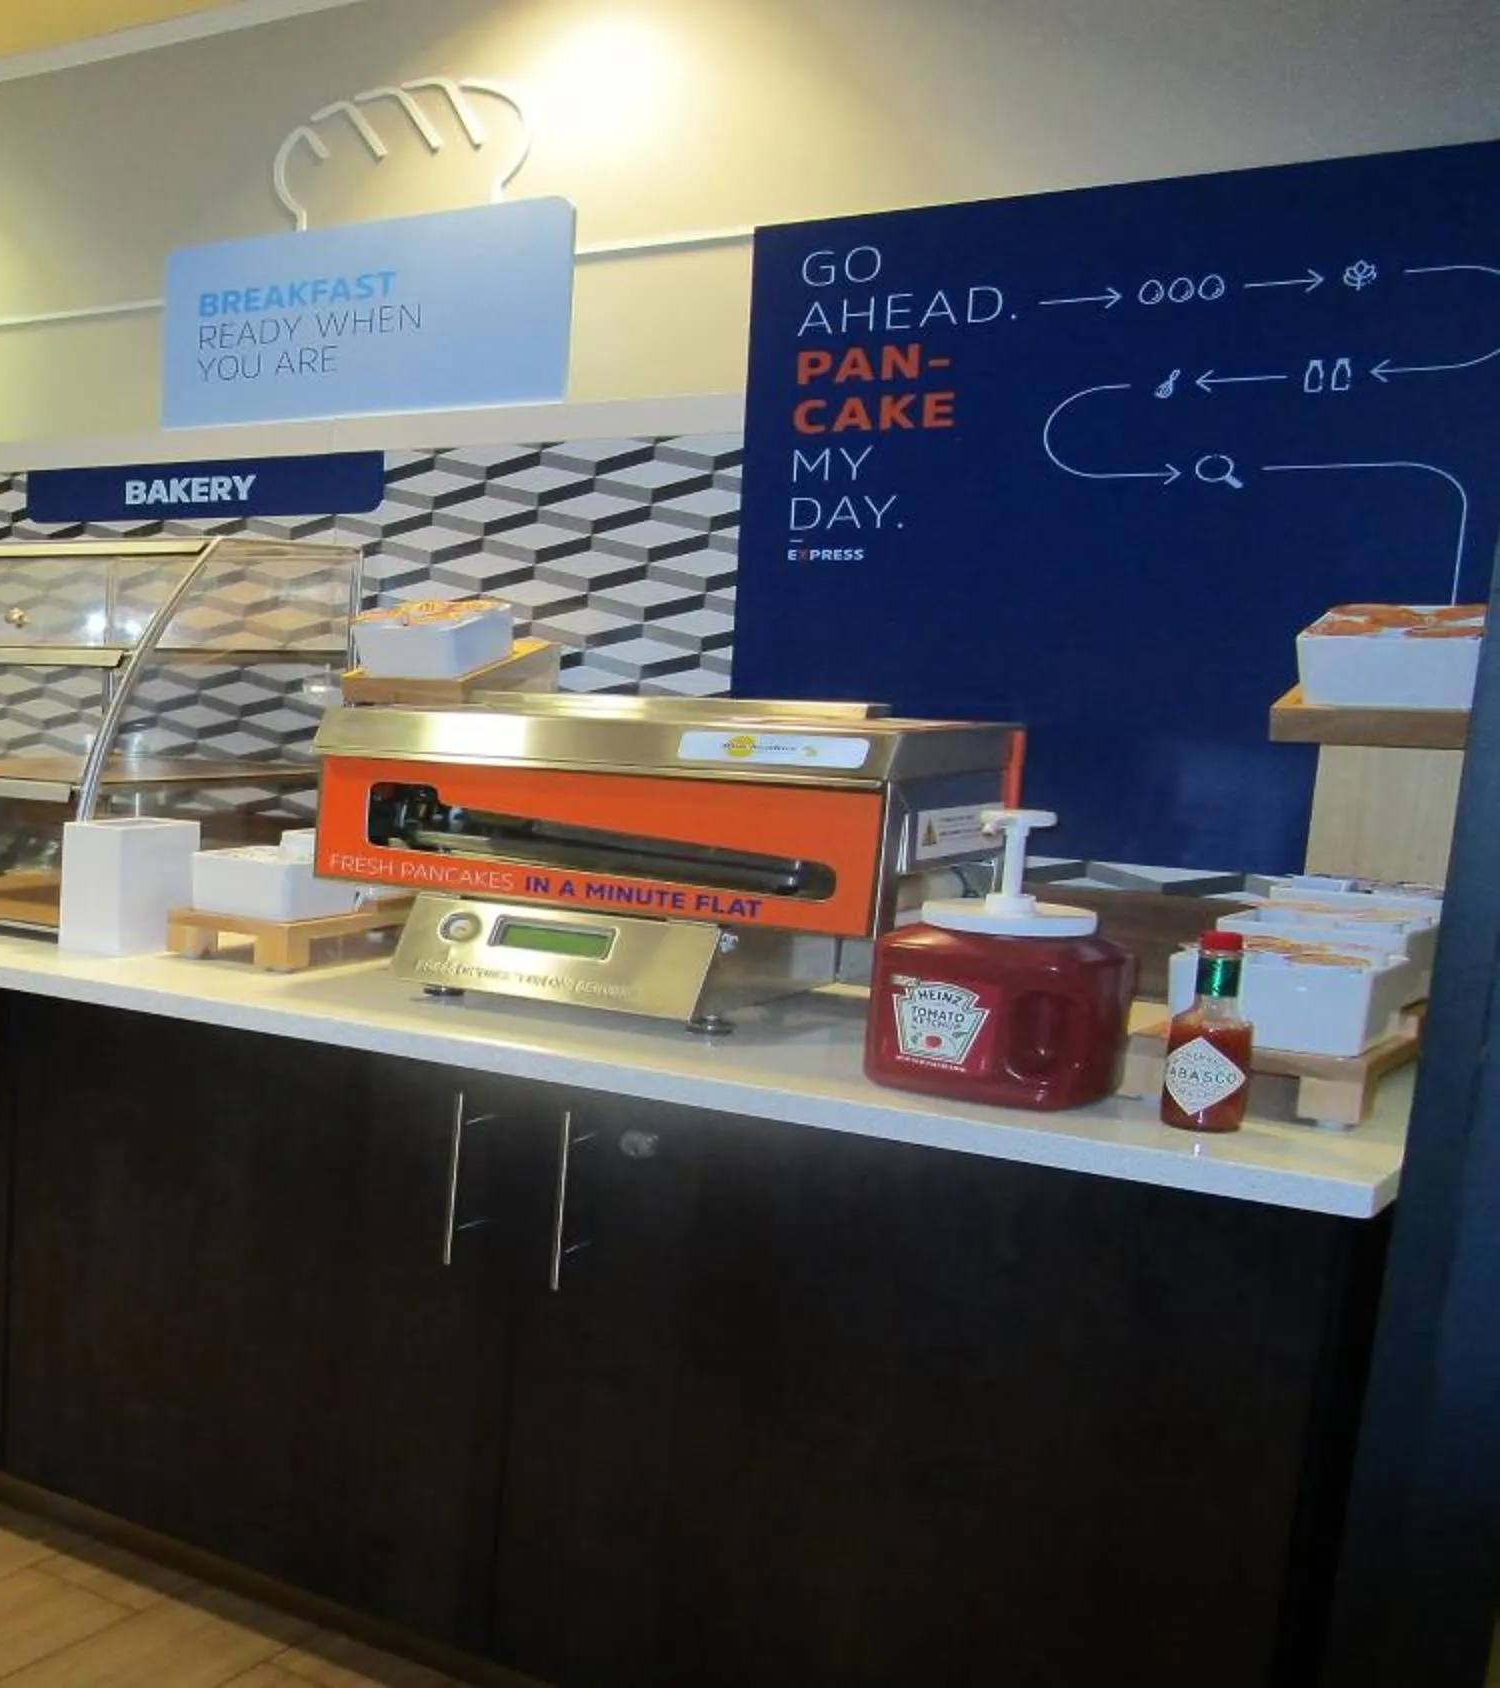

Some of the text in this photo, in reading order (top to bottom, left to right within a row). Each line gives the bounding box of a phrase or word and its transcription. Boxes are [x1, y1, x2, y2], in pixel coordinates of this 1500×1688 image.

[802, 246, 882, 287] GO
[200, 270, 396, 318] BREAKFAST
[797, 286, 1017, 336] AHEAD.
[199, 302, 423, 351] READY WHEN
[197, 345, 338, 382] YOU ARE
[796, 343, 951, 385] PAN-
[792, 391, 956, 434] CAKE
[792, 445, 873, 482] MY
[124, 474, 257, 505] BAKERY
[789, 495, 904, 531] DAY.
[787, 548, 864, 562] EXPRESS
[329, 853, 763, 917] FRESH PANCAKES IN A MINUTE FLAT
[911, 1006, 965, 1023] TOMATO
[918, 989, 964, 1005] HEINZ
[1169, 1066, 1237, 1085] ABASCO
